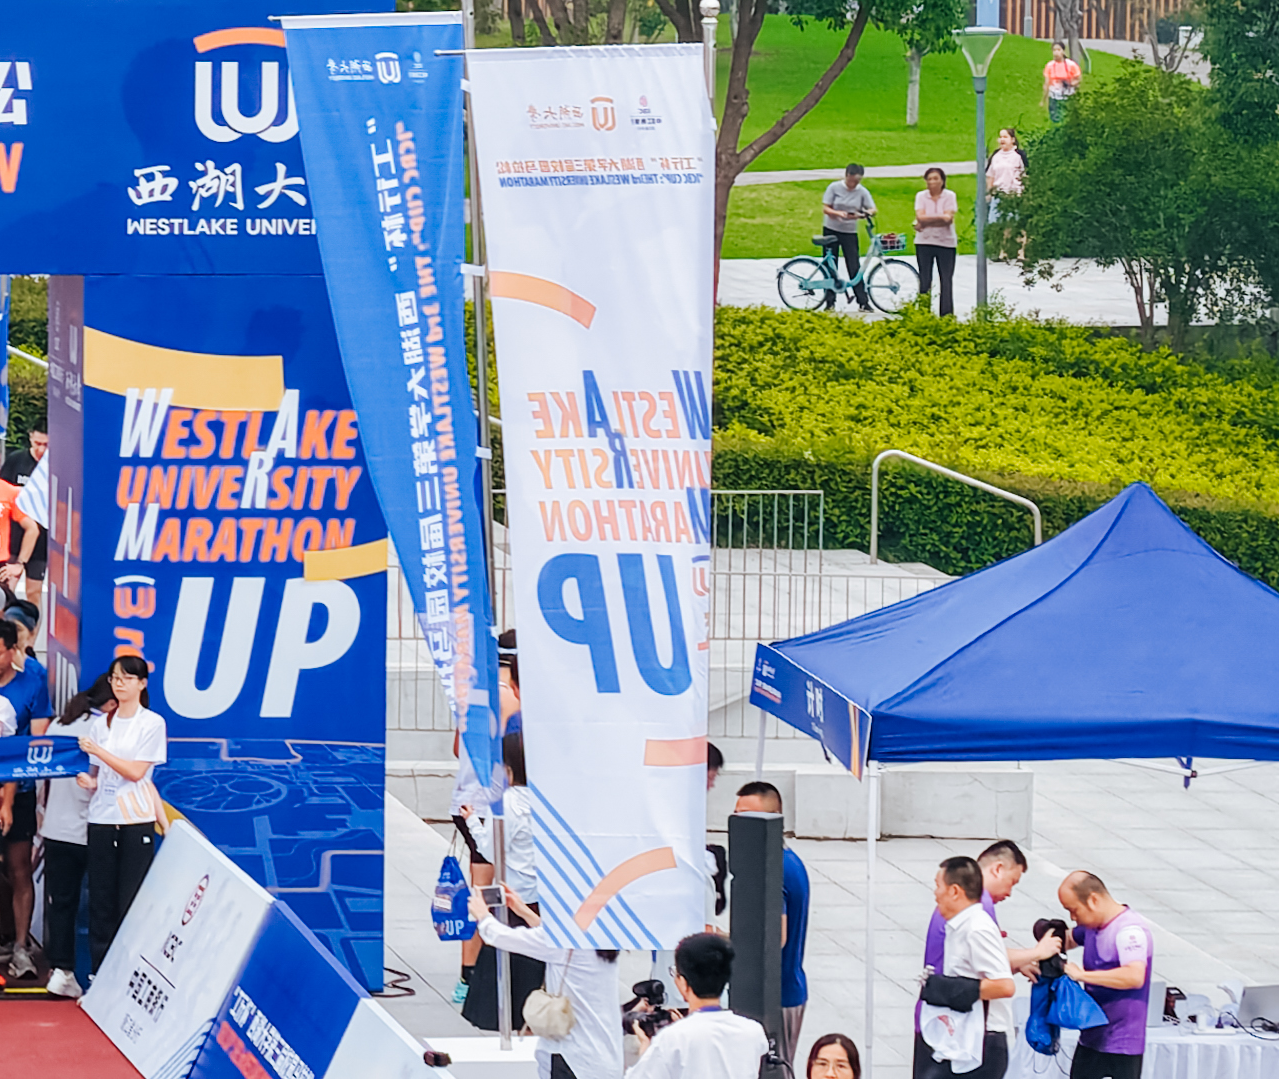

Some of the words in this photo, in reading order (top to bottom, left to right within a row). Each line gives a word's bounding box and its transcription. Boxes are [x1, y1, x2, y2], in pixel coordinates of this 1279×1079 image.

[126, 218, 238, 236] WESTLAKE
[118, 388, 359, 460] WESTLAKE
[116, 451, 363, 511] UNIVERSITY
[114, 503, 356, 564] MARATHON
[163, 577, 362, 720] UP
